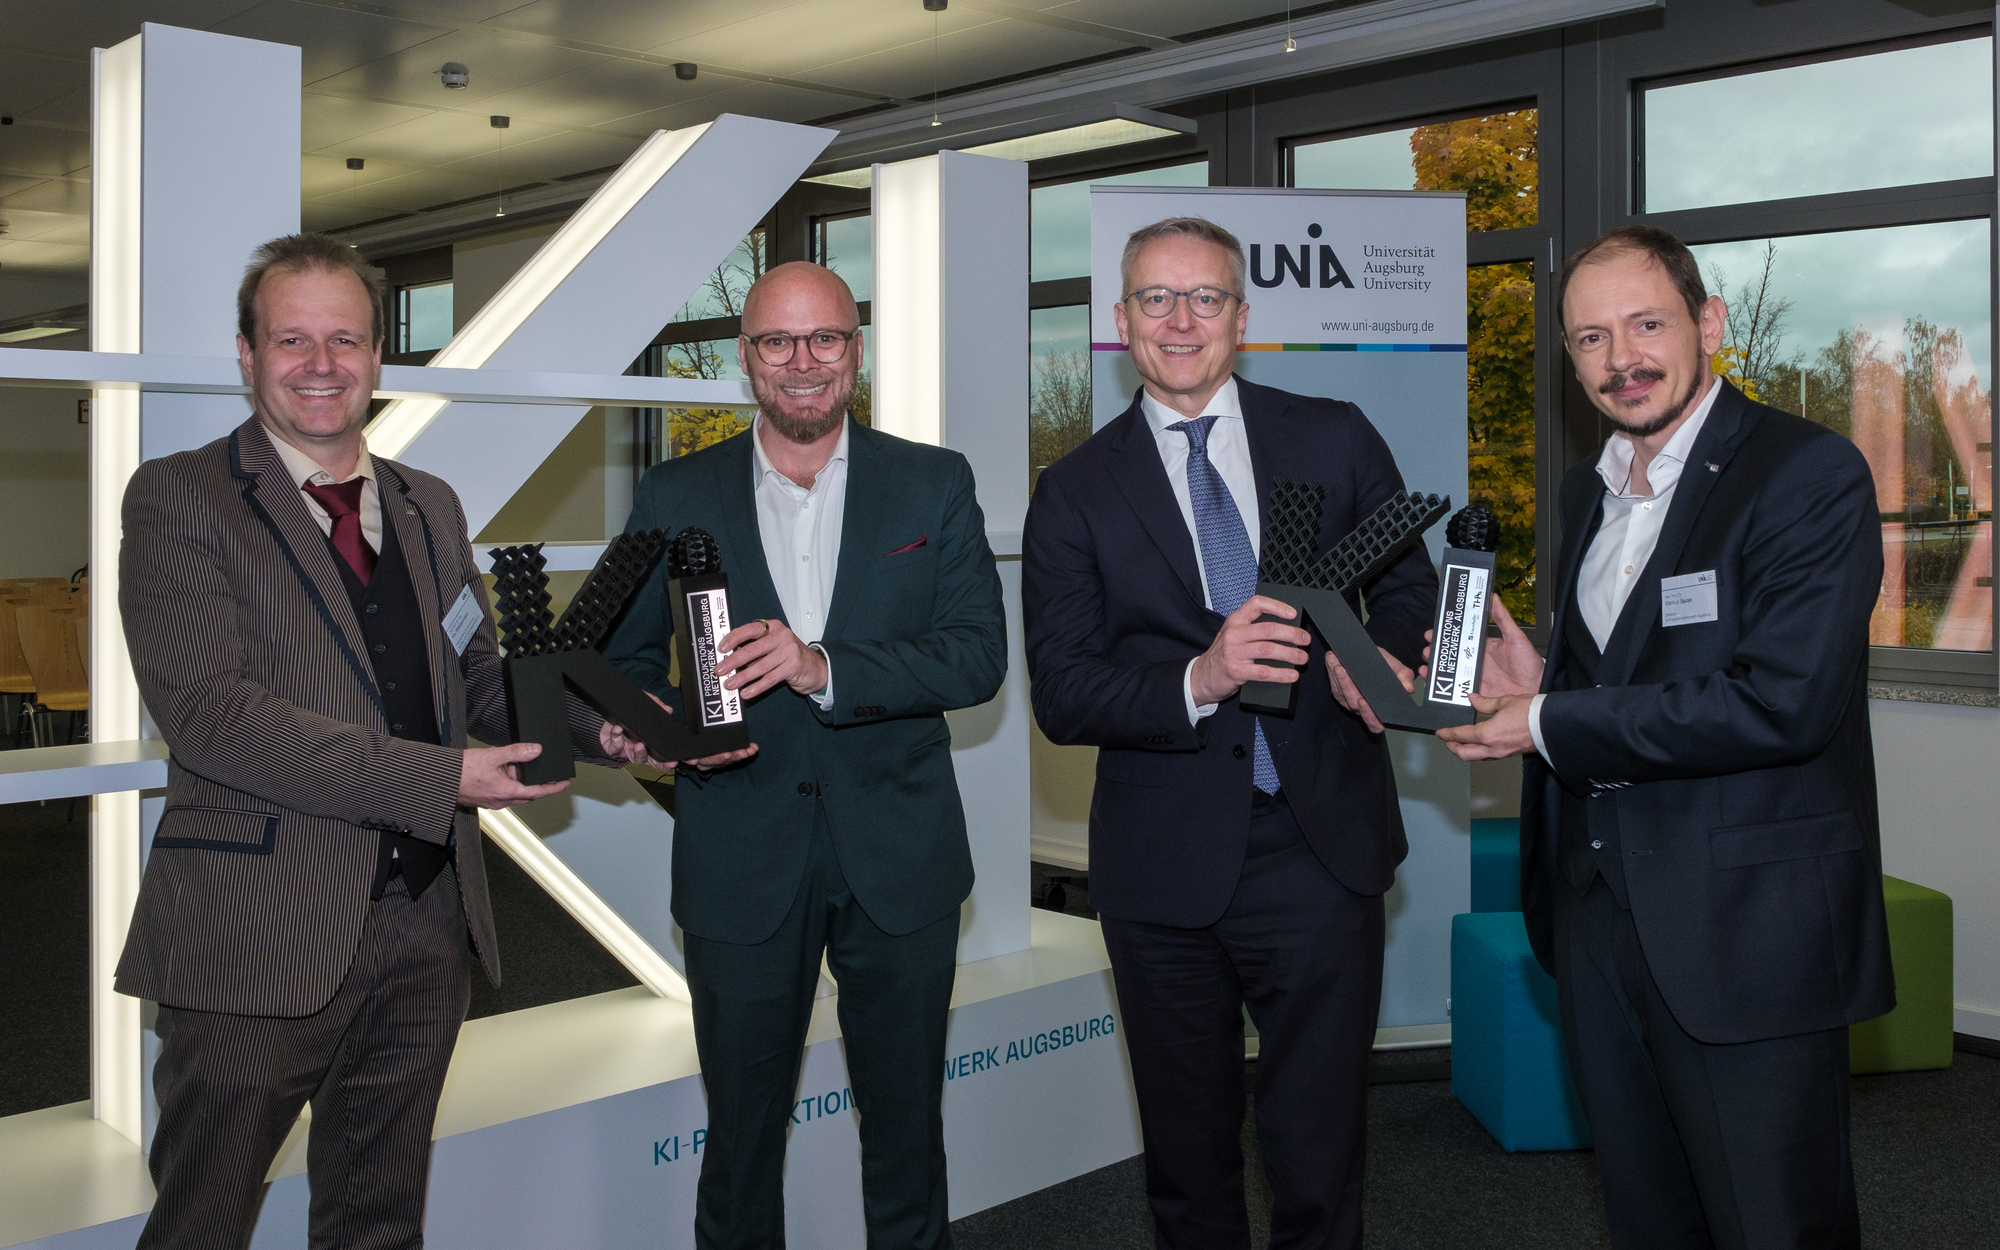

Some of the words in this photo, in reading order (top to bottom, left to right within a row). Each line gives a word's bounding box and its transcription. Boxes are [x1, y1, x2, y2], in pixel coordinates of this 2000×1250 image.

[1363, 245, 1435, 258] Universität
[1363, 261, 1425, 276] Augsburg
[1363, 277, 1432, 293] University
[1321, 319, 1434, 334] www.uni-augsburg.de
[700, 598, 713, 645] AUGSBURG
[1447, 625, 1461, 674] NETZWERK
[1454, 573, 1468, 622] AUGSBURG
[1438, 610, 1454, 672] PRODUKTIONS
[698, 636, 712, 697] PRODUKTIONS
[1435, 676, 1454, 696] KI
[706, 699, 723, 719] KI
[1005, 1014, 1115, 1064] AUGSBURG
